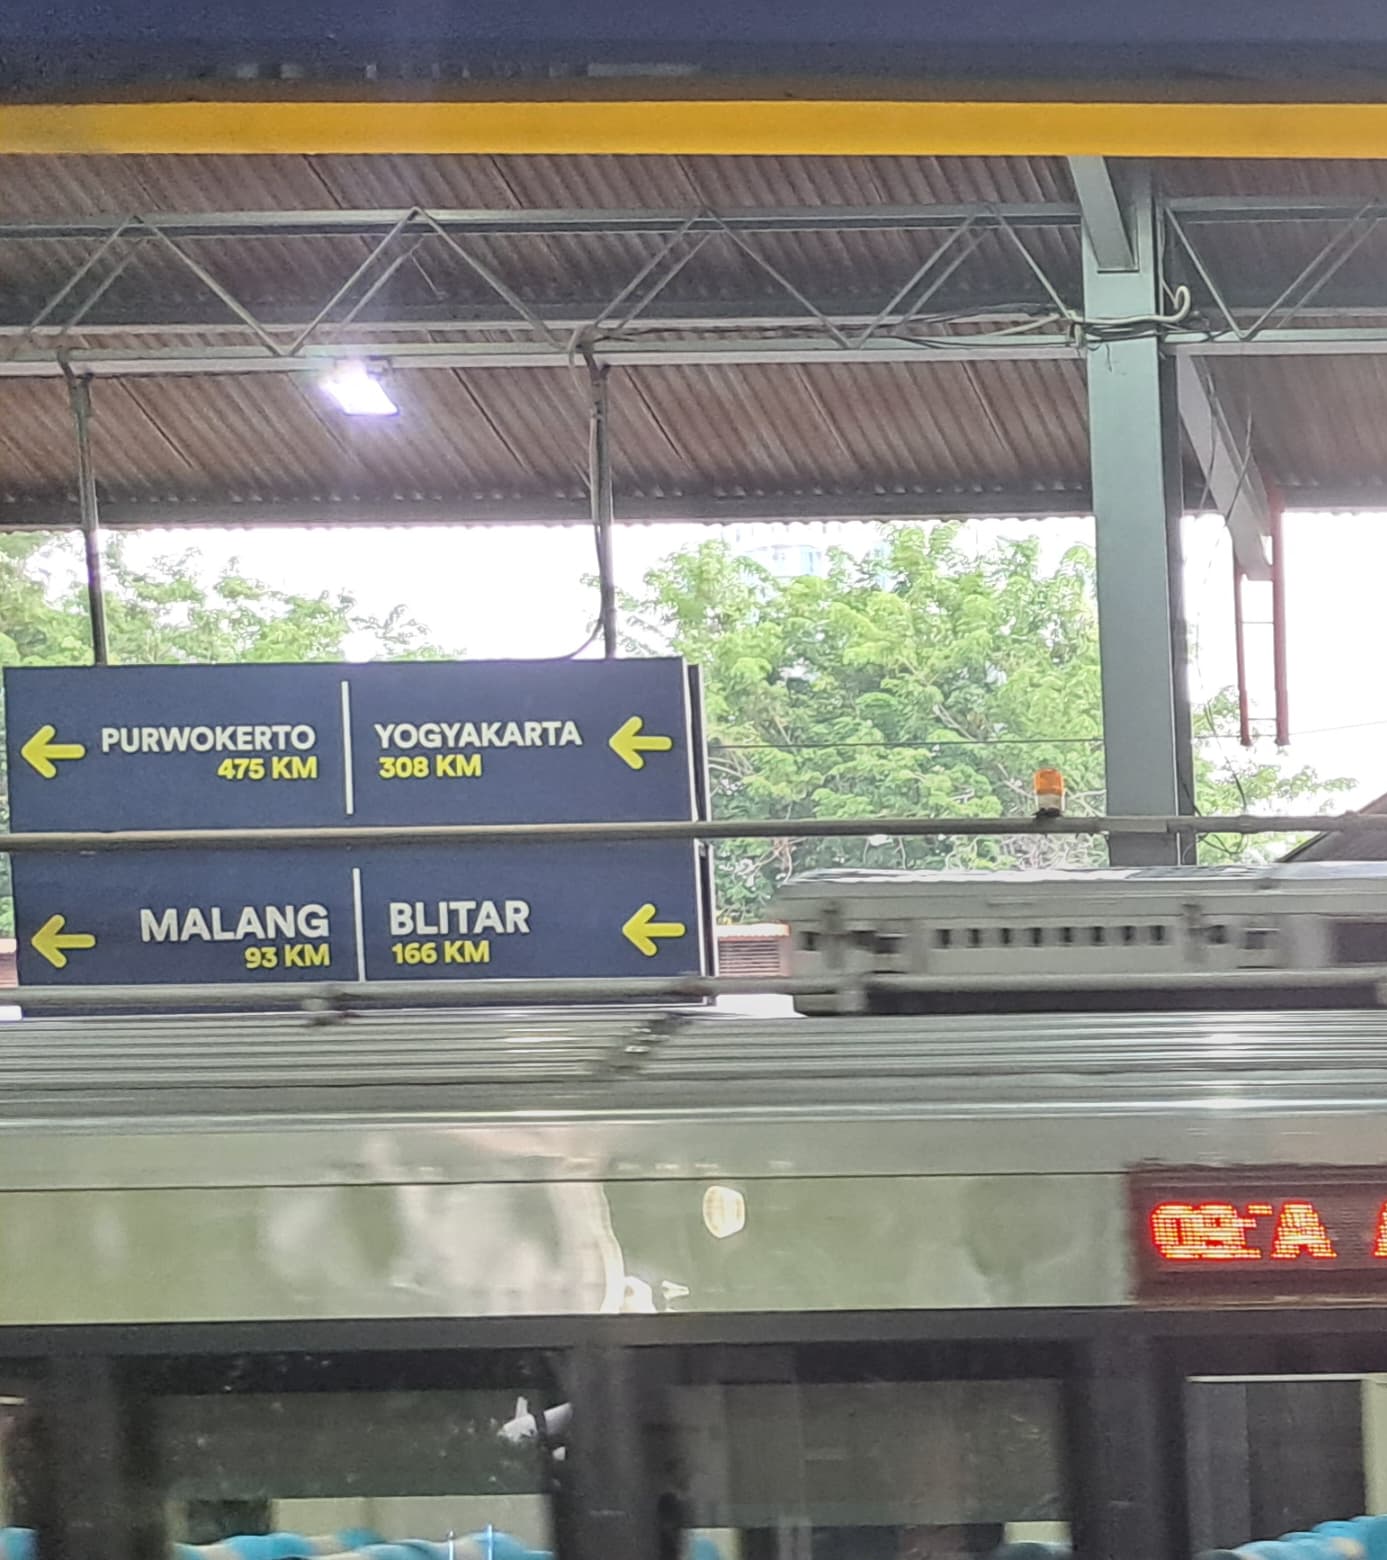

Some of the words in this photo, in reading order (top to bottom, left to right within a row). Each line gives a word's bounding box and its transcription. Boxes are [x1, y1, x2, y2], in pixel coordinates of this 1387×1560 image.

[102, 724, 315, 754] PURWOKERTO
[374, 721, 582, 750] YOGYAKARTA
[217, 756, 264, 780] 475
[272, 755, 318, 779] KM
[379, 755, 429, 779] 308
[437, 754, 482, 778] KM
[140, 904, 329, 942] MALANG
[390, 900, 531, 936] BLITAR
[245, 945, 278, 969] 93
[285, 944, 330, 968] KM
[392, 942, 436, 966] 166
[444, 940, 490, 964] KM
